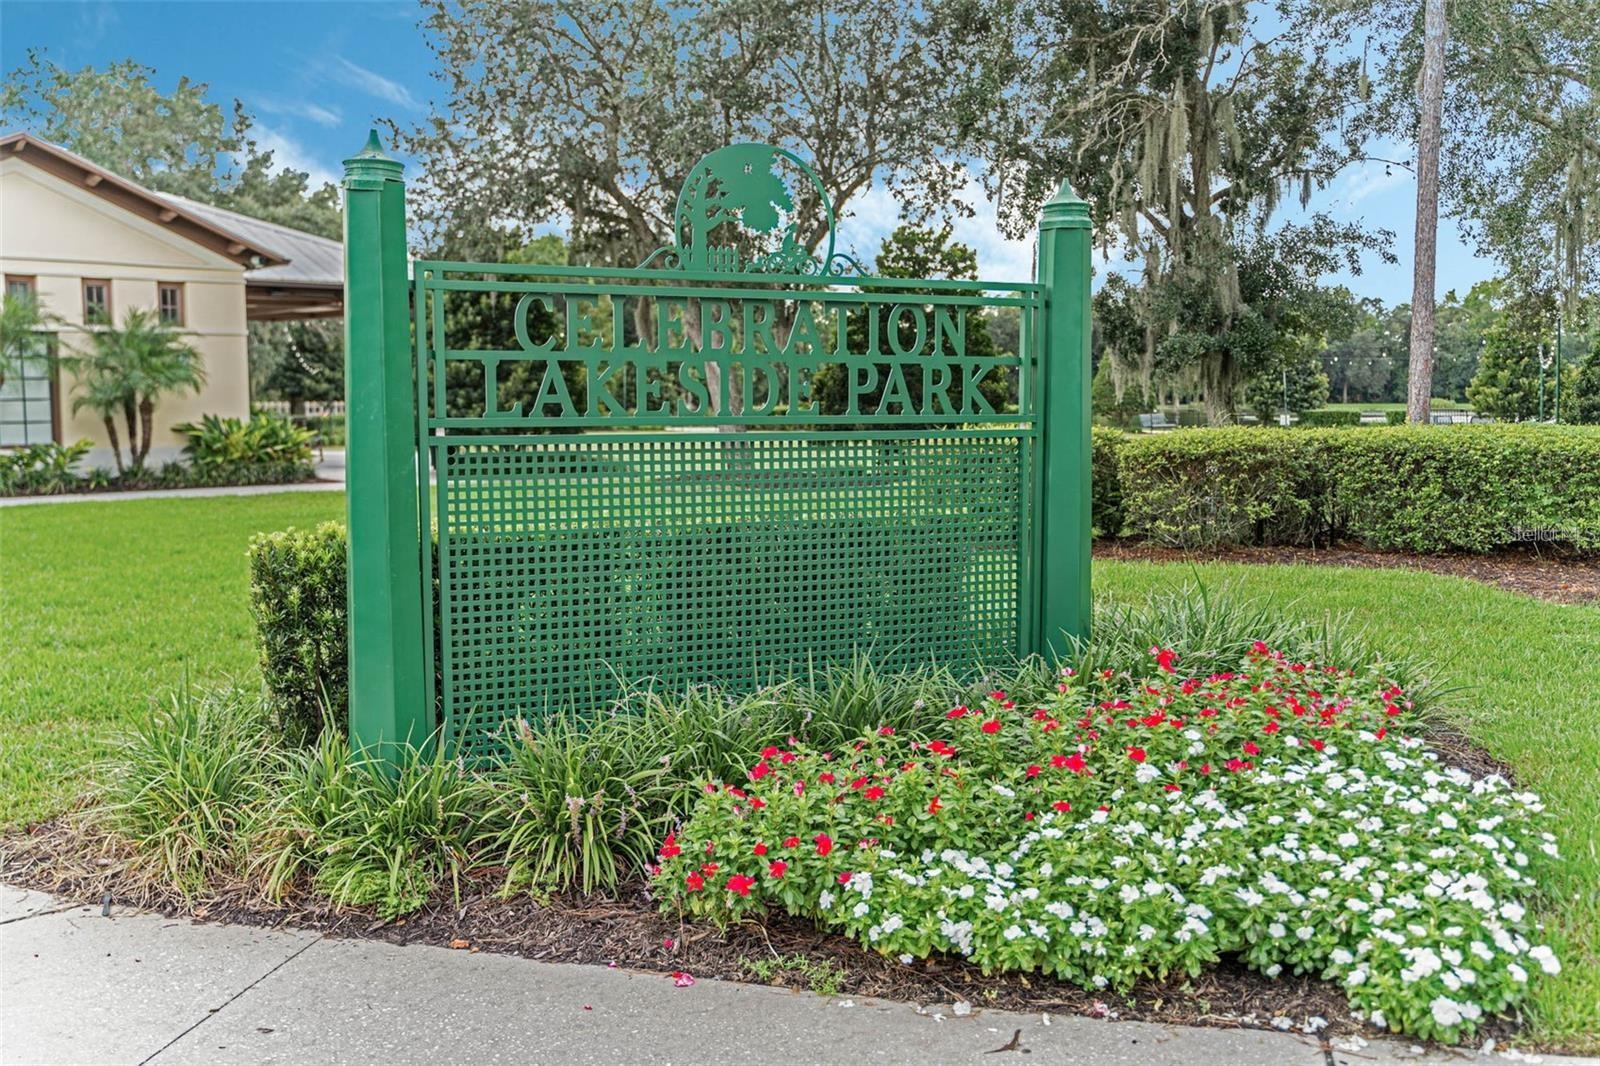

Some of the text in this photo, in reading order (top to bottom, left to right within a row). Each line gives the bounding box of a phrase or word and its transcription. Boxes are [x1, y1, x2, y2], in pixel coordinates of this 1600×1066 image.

[514, 294, 968, 358] CELEBRATION
[482, 359, 1002, 418] LAKESIDE PARK
